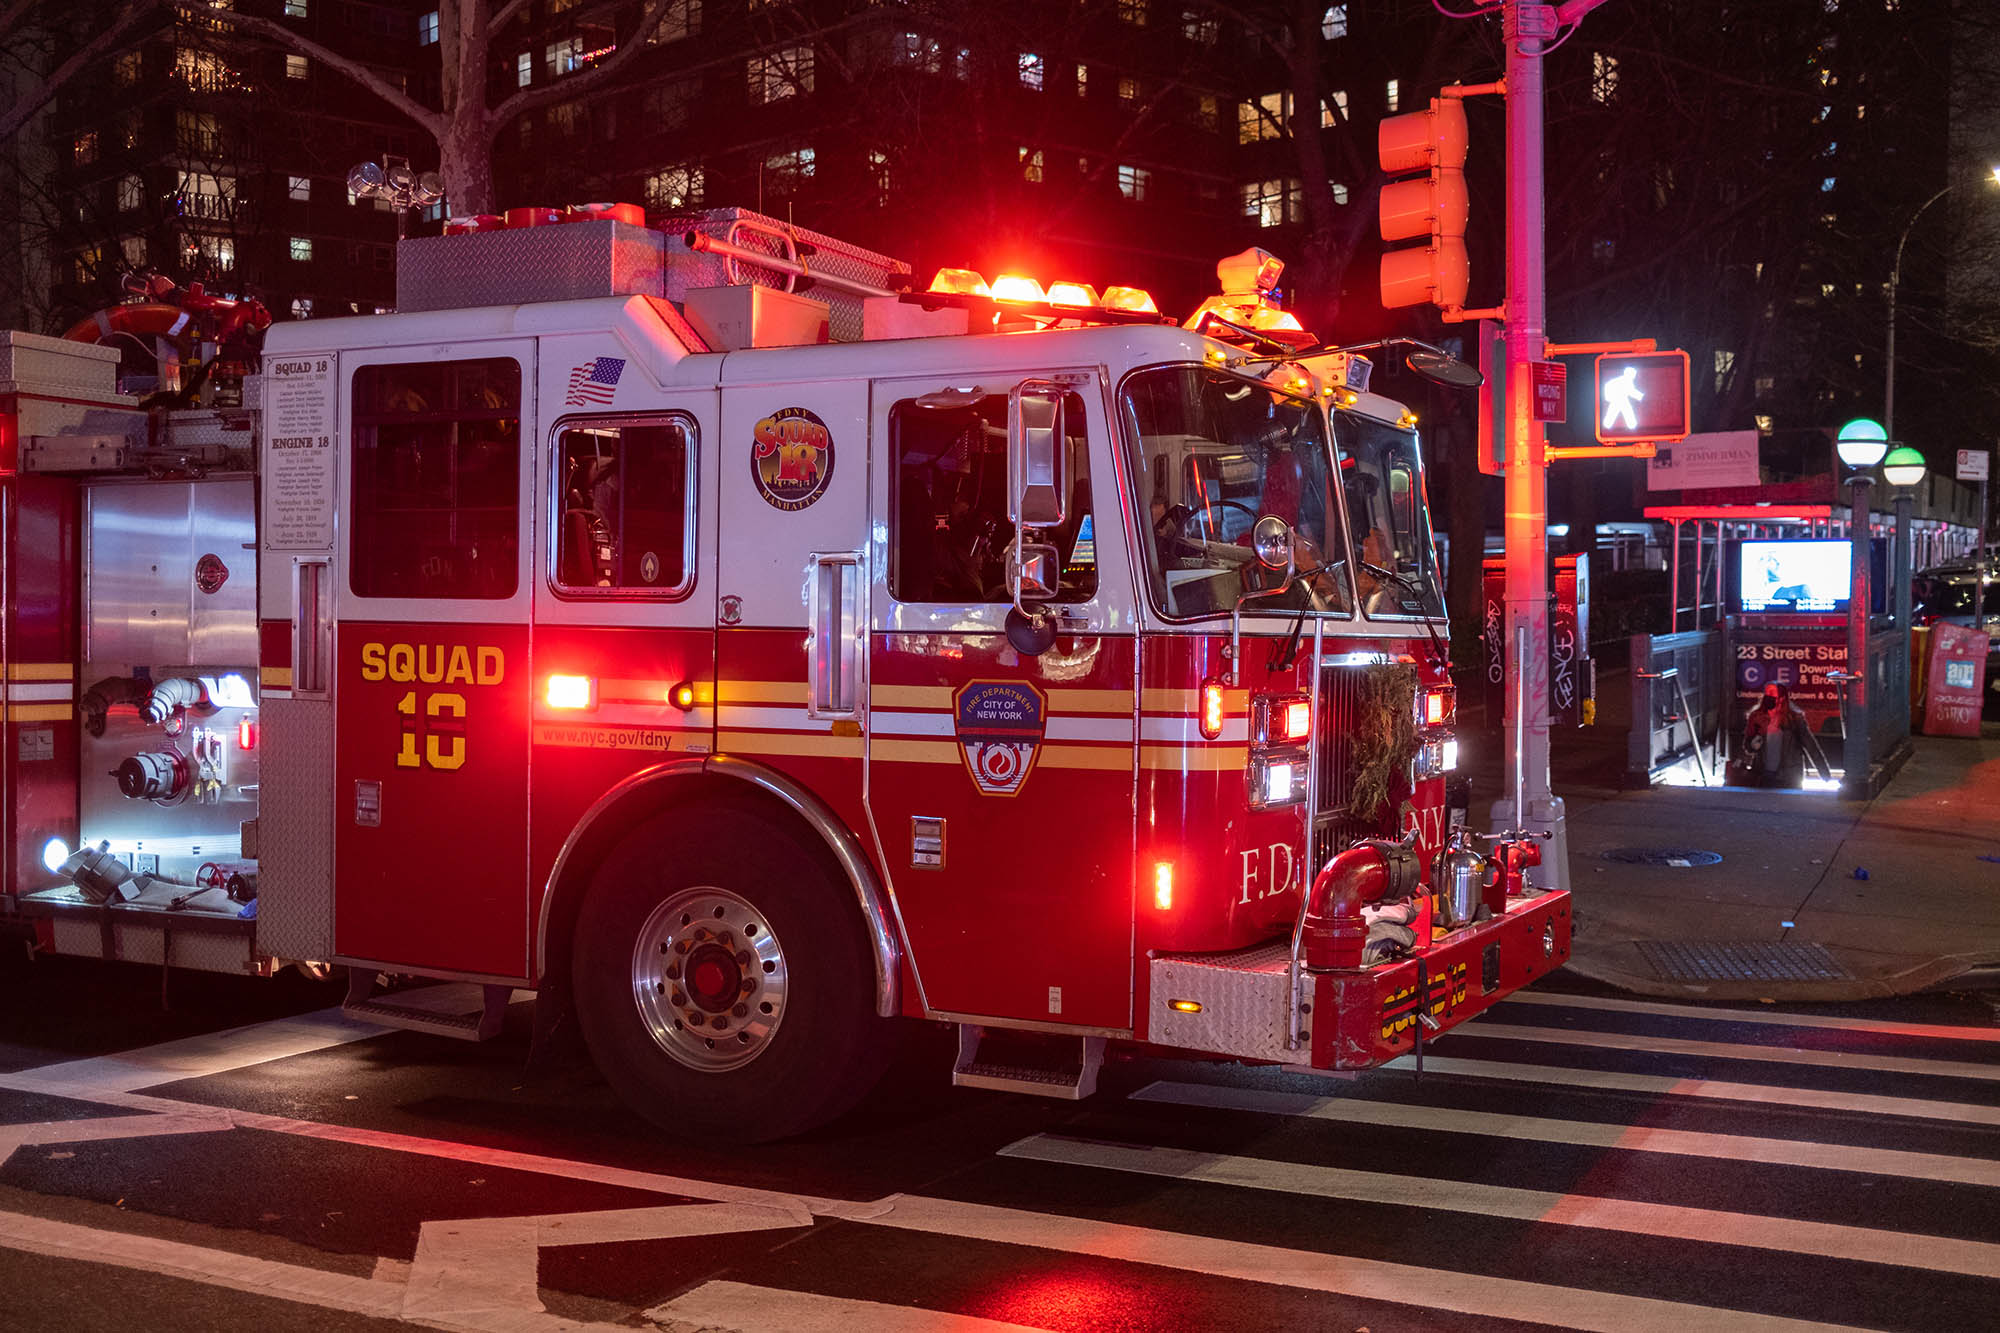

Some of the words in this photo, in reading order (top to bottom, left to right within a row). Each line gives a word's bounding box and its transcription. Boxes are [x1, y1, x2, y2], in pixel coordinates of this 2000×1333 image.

[275, 362, 311, 376] SQUAD
[316, 361, 327, 372] 18
[1538, 384, 1560, 399] WRONG
[777, 408, 809, 419] FDNY
[1543, 401, 1556, 416] WAY
[272, 437, 313, 449] ENGINE
[318, 436, 329, 448] 18
[776, 441, 818, 482] 18
[763, 490, 823, 511] MANHATTAN
[1737, 646, 1757, 660] 23
[1763, 646, 1810, 660] Street
[362, 643, 505, 685] SQUAD
[1744, 667, 1759, 682] C
[1777, 667, 1790, 683] E
[966, 694, 981, 713] FIRE
[982, 687, 1034, 713] DEPARTMENT
[1788, 691, 1816, 700] Uptown
[983, 700, 1002, 709] CITY
[1004, 700, 1016, 709] OF
[977, 710, 998, 719] NEW
[999, 711, 1022, 720] YORK
[543, 729, 672, 751] www.nyc.gov/fdny
[1239, 843, 1297, 905] F.D.
